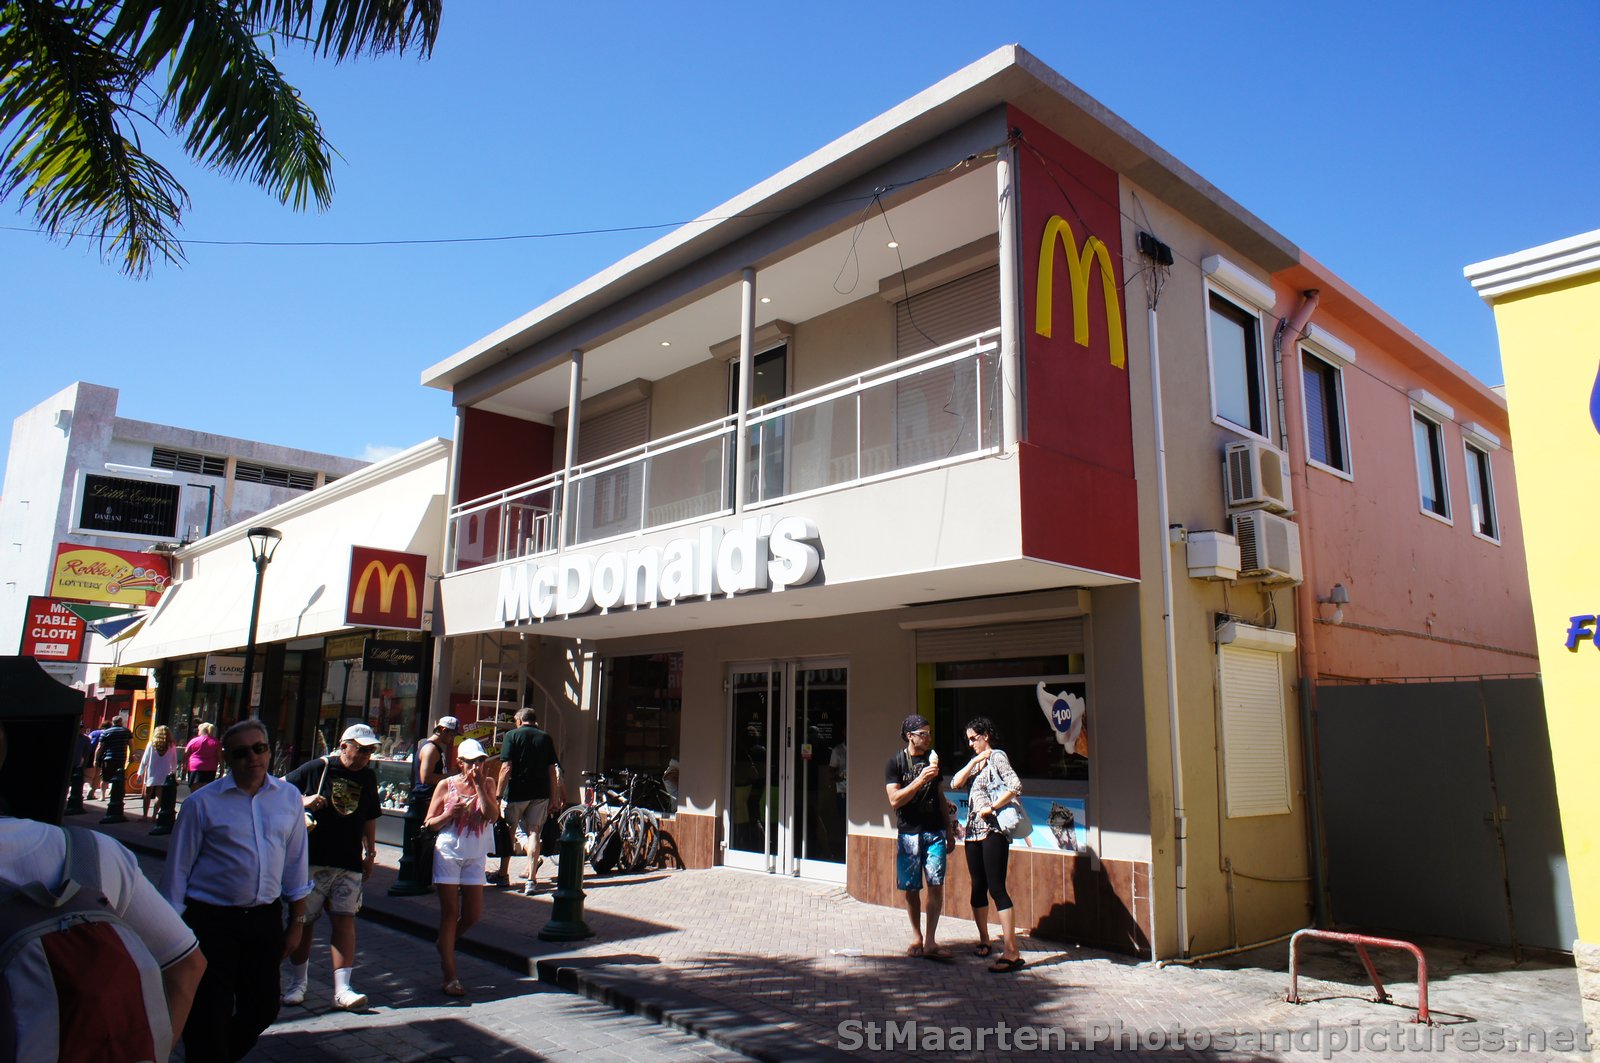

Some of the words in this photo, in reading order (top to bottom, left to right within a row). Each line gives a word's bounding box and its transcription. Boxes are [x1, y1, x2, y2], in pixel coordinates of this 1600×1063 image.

[495, 514, 821, 624] McDonald's
[59, 578, 103, 589] LOTTERY
[35, 614, 78, 627] TABLE
[31, 628, 77, 640] CLOTH
[370, 648, 390, 659] Little
[390, 648, 416, 664] Europe
